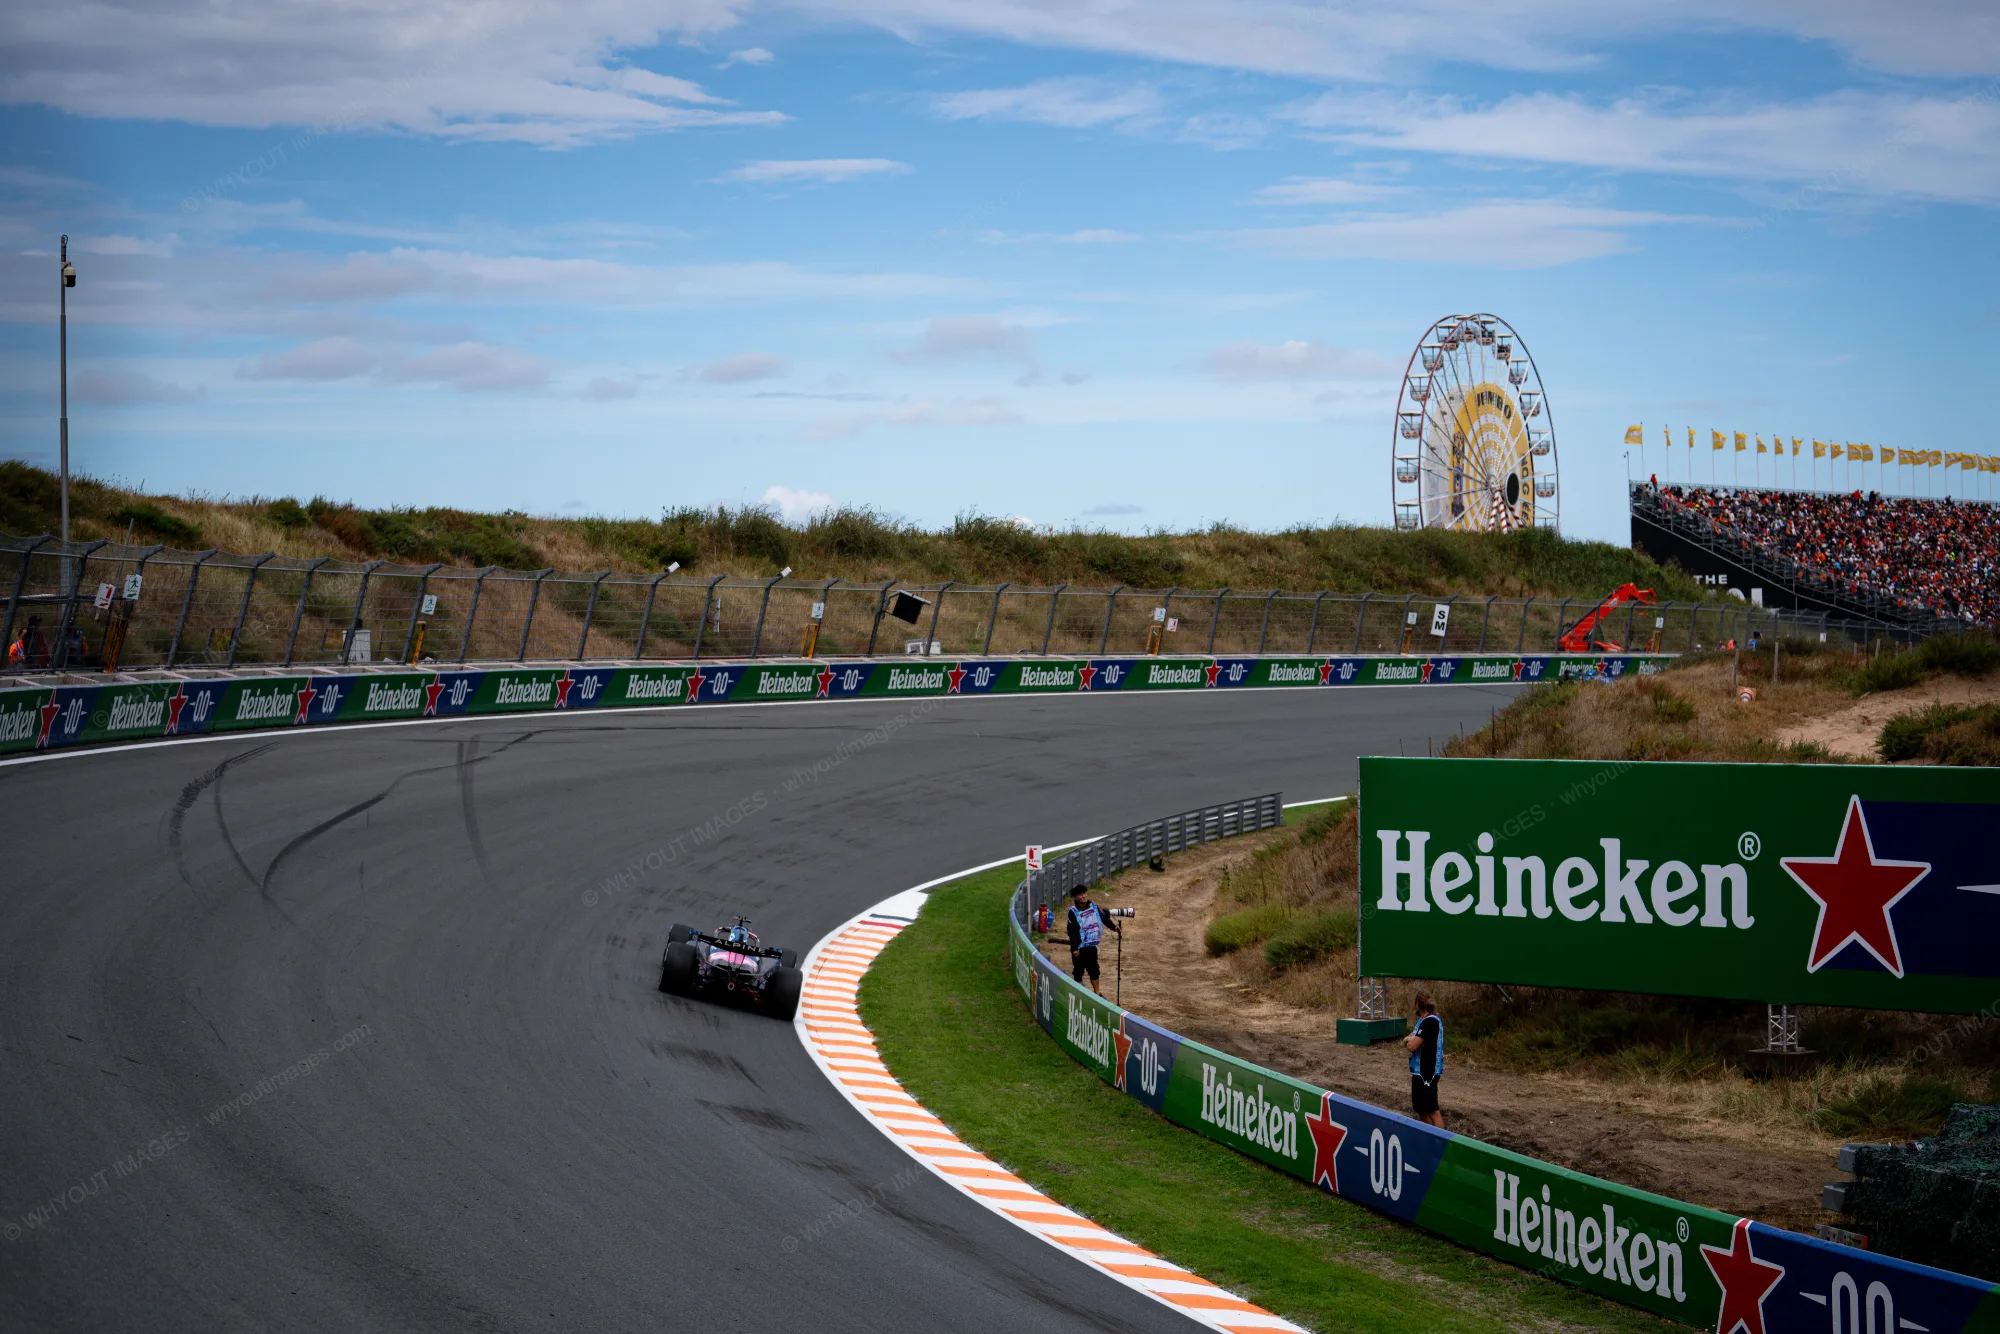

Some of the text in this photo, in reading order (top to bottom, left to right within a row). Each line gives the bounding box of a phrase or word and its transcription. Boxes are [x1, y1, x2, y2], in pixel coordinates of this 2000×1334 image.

[1693, 574, 1728, 585] THE
[888, 668, 943, 690] Heineken
[1020, 666, 1074, 686] Heineken
[1148, 664, 1201, 684] Heineken
[1268, 663, 1315, 682] Heineken
[1375, 662, 1418, 680] Heineken
[1472, 661, 1510, 678] Heineken
[495, 677, 552, 704] Heineken
[625, 674, 682, 699] Heineken
[757, 671, 813, 694] Heineken
[236, 686, 293, 720] Heineken
[365, 682, 422, 712] Heineken
[107, 694, 165, 731] Heineken
[1376, 830, 1756, 930] Heineken
[714, 939, 766, 953] ALPINE
[1067, 992, 1110, 1068] Heineken
[1201, 1062, 1299, 1161] Heineken
[1493, 1168, 1688, 1303] Heineken
